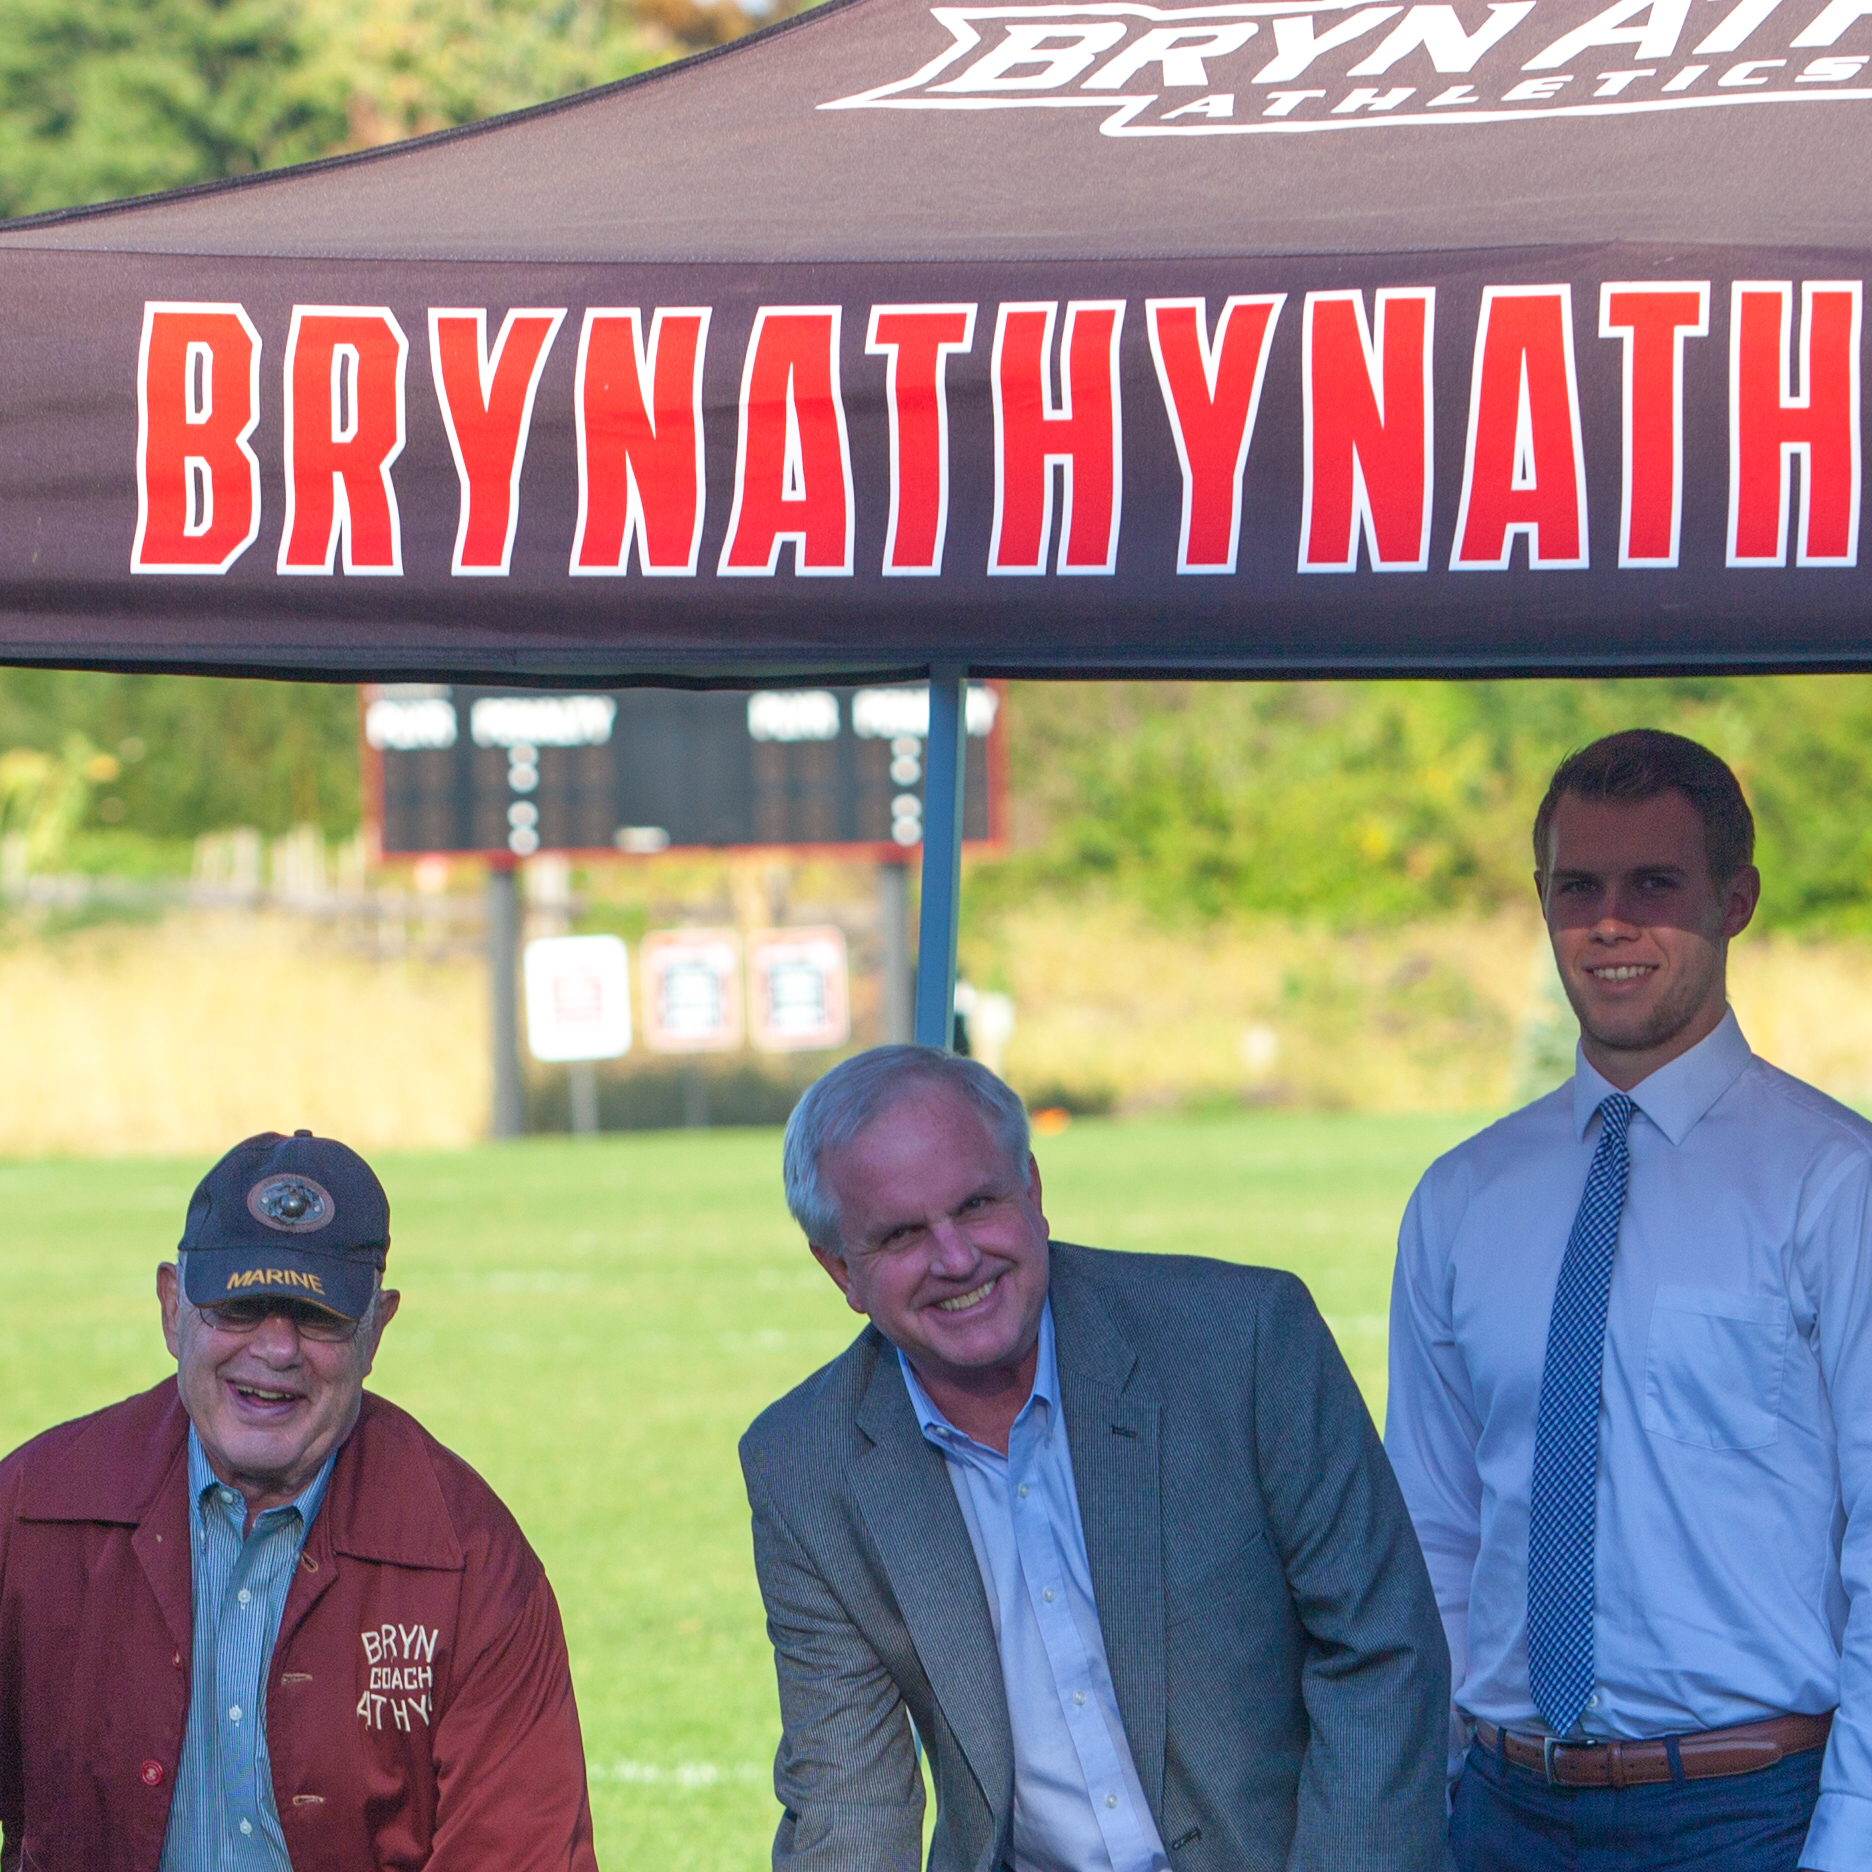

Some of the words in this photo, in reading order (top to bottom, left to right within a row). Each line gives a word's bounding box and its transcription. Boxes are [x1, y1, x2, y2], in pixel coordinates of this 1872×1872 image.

[925, 2, 1532, 93] BRYN
[1159, 55, 1871, 120] ATHLETICS
[226, 1267, 326, 1296] MARINE
[360, 1623, 440, 1666] BRYN
[369, 1665, 434, 1691] COACH
